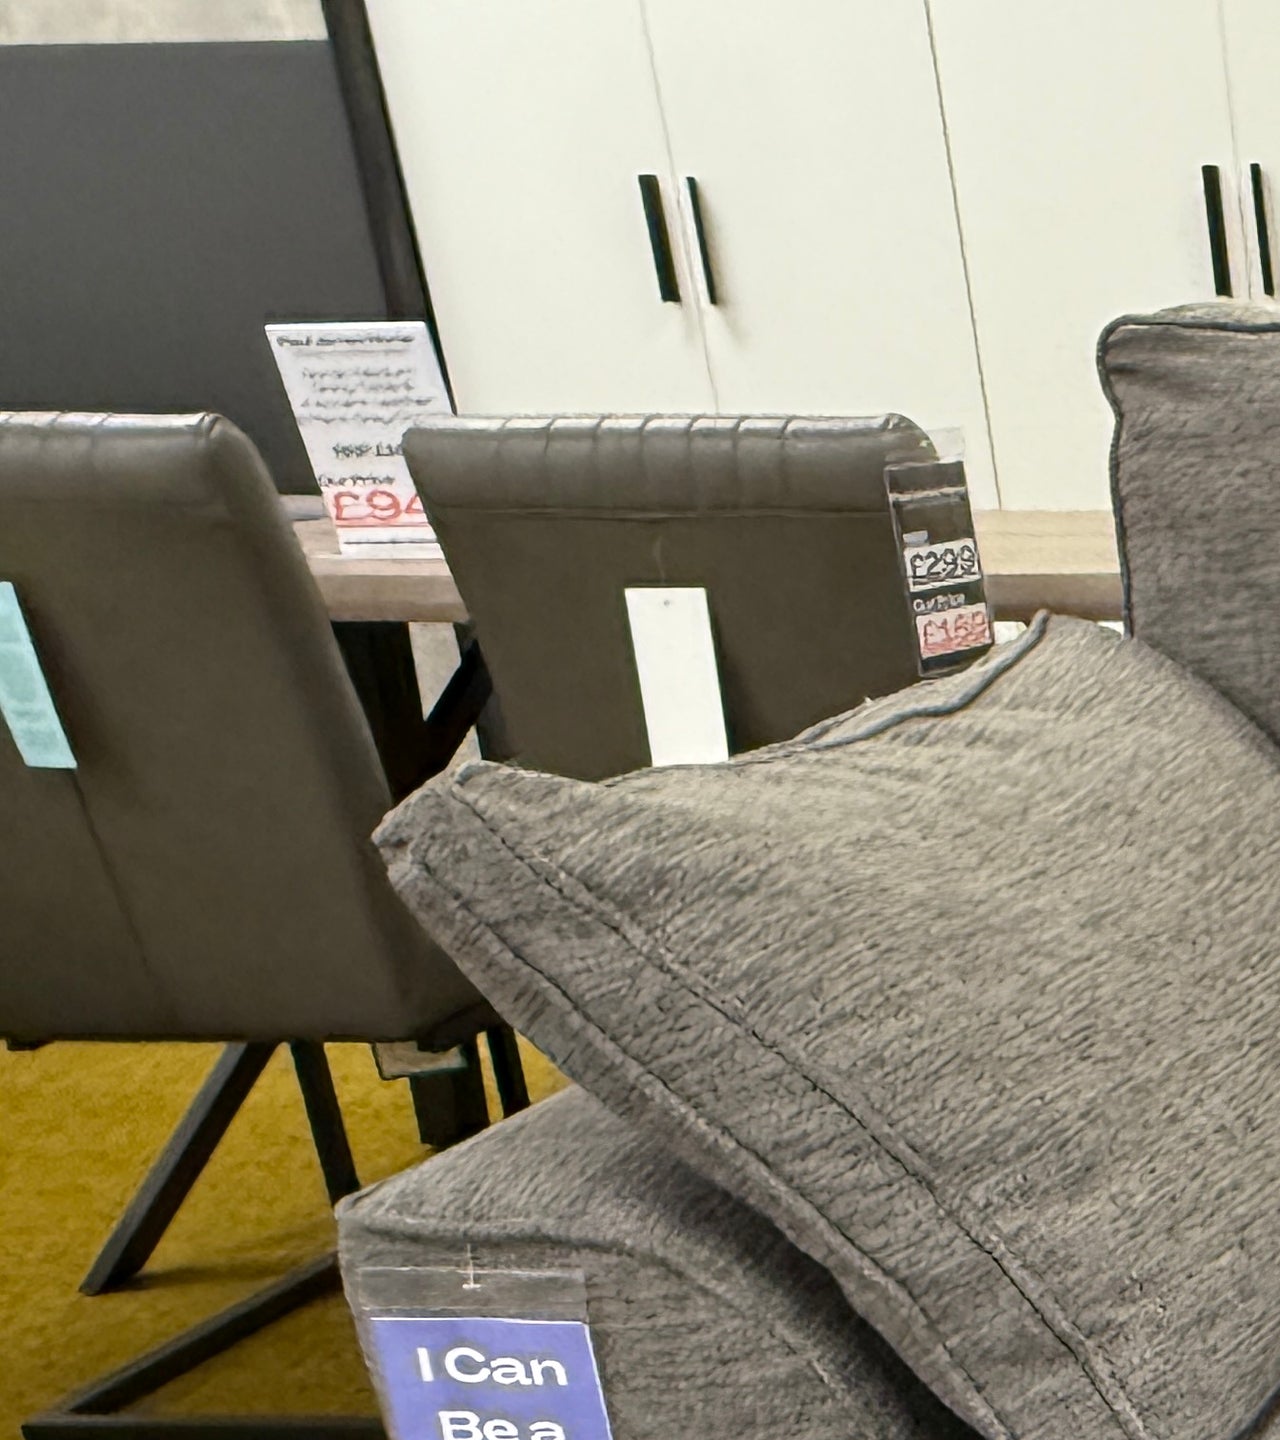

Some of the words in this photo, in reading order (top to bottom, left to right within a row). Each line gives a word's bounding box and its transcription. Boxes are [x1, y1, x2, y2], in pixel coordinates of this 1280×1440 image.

[909, 545, 976, 578] £299
[416, 1347, 434, 1382] I
[444, 1347, 569, 1386] Can
